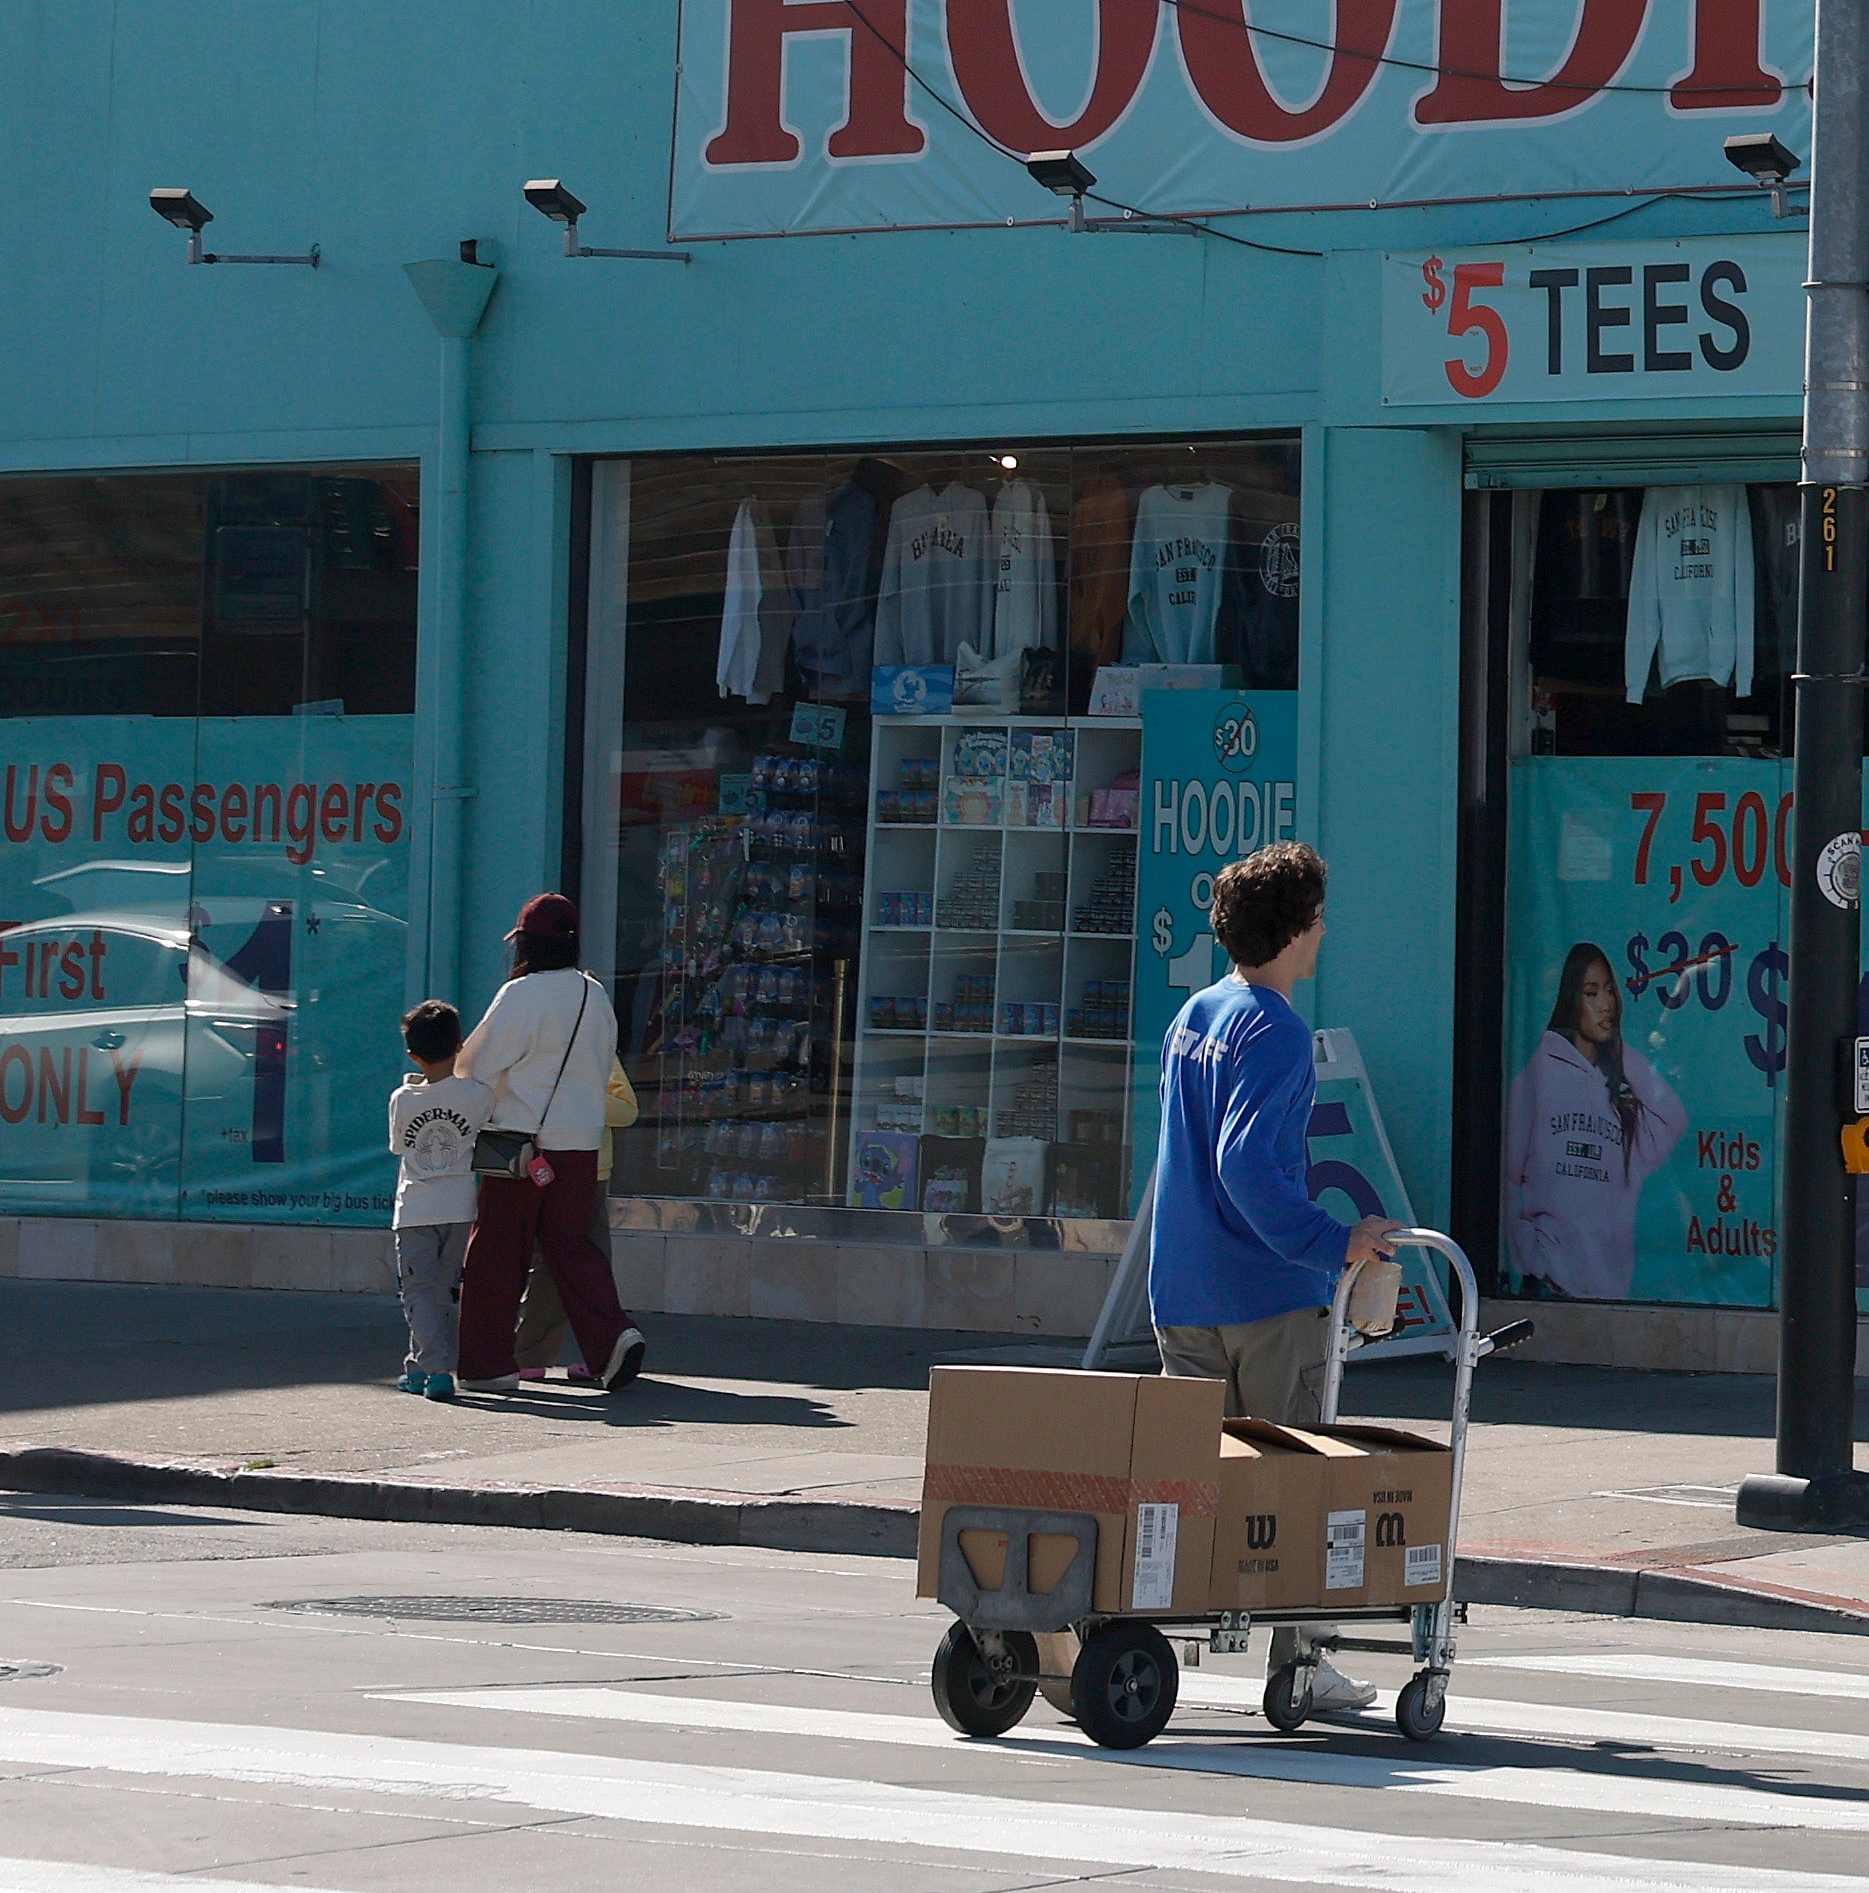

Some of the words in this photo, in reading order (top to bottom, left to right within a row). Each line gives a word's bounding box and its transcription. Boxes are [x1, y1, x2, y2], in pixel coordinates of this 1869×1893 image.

[1422, 254, 1509, 398] $5
[1529, 259, 1750, 376] TEES
[1822, 487, 1838, 572] 261
[1215, 718, 1257, 758] $30
[93, 763, 403, 865] Passengers
[1625, 930, 1732, 1012] $30
[0, 1044, 143, 1127] ONLY
[1698, 1131, 1761, 1171] Kids
[252, 1189, 287, 1207] show
[290, 1194, 319, 1215] your
[323, 1192, 341, 1212] big
[346, 1192, 369, 1209] bus
[1717, 1174, 1737, 1213] &
[1686, 1216, 1778, 1258] Adults
